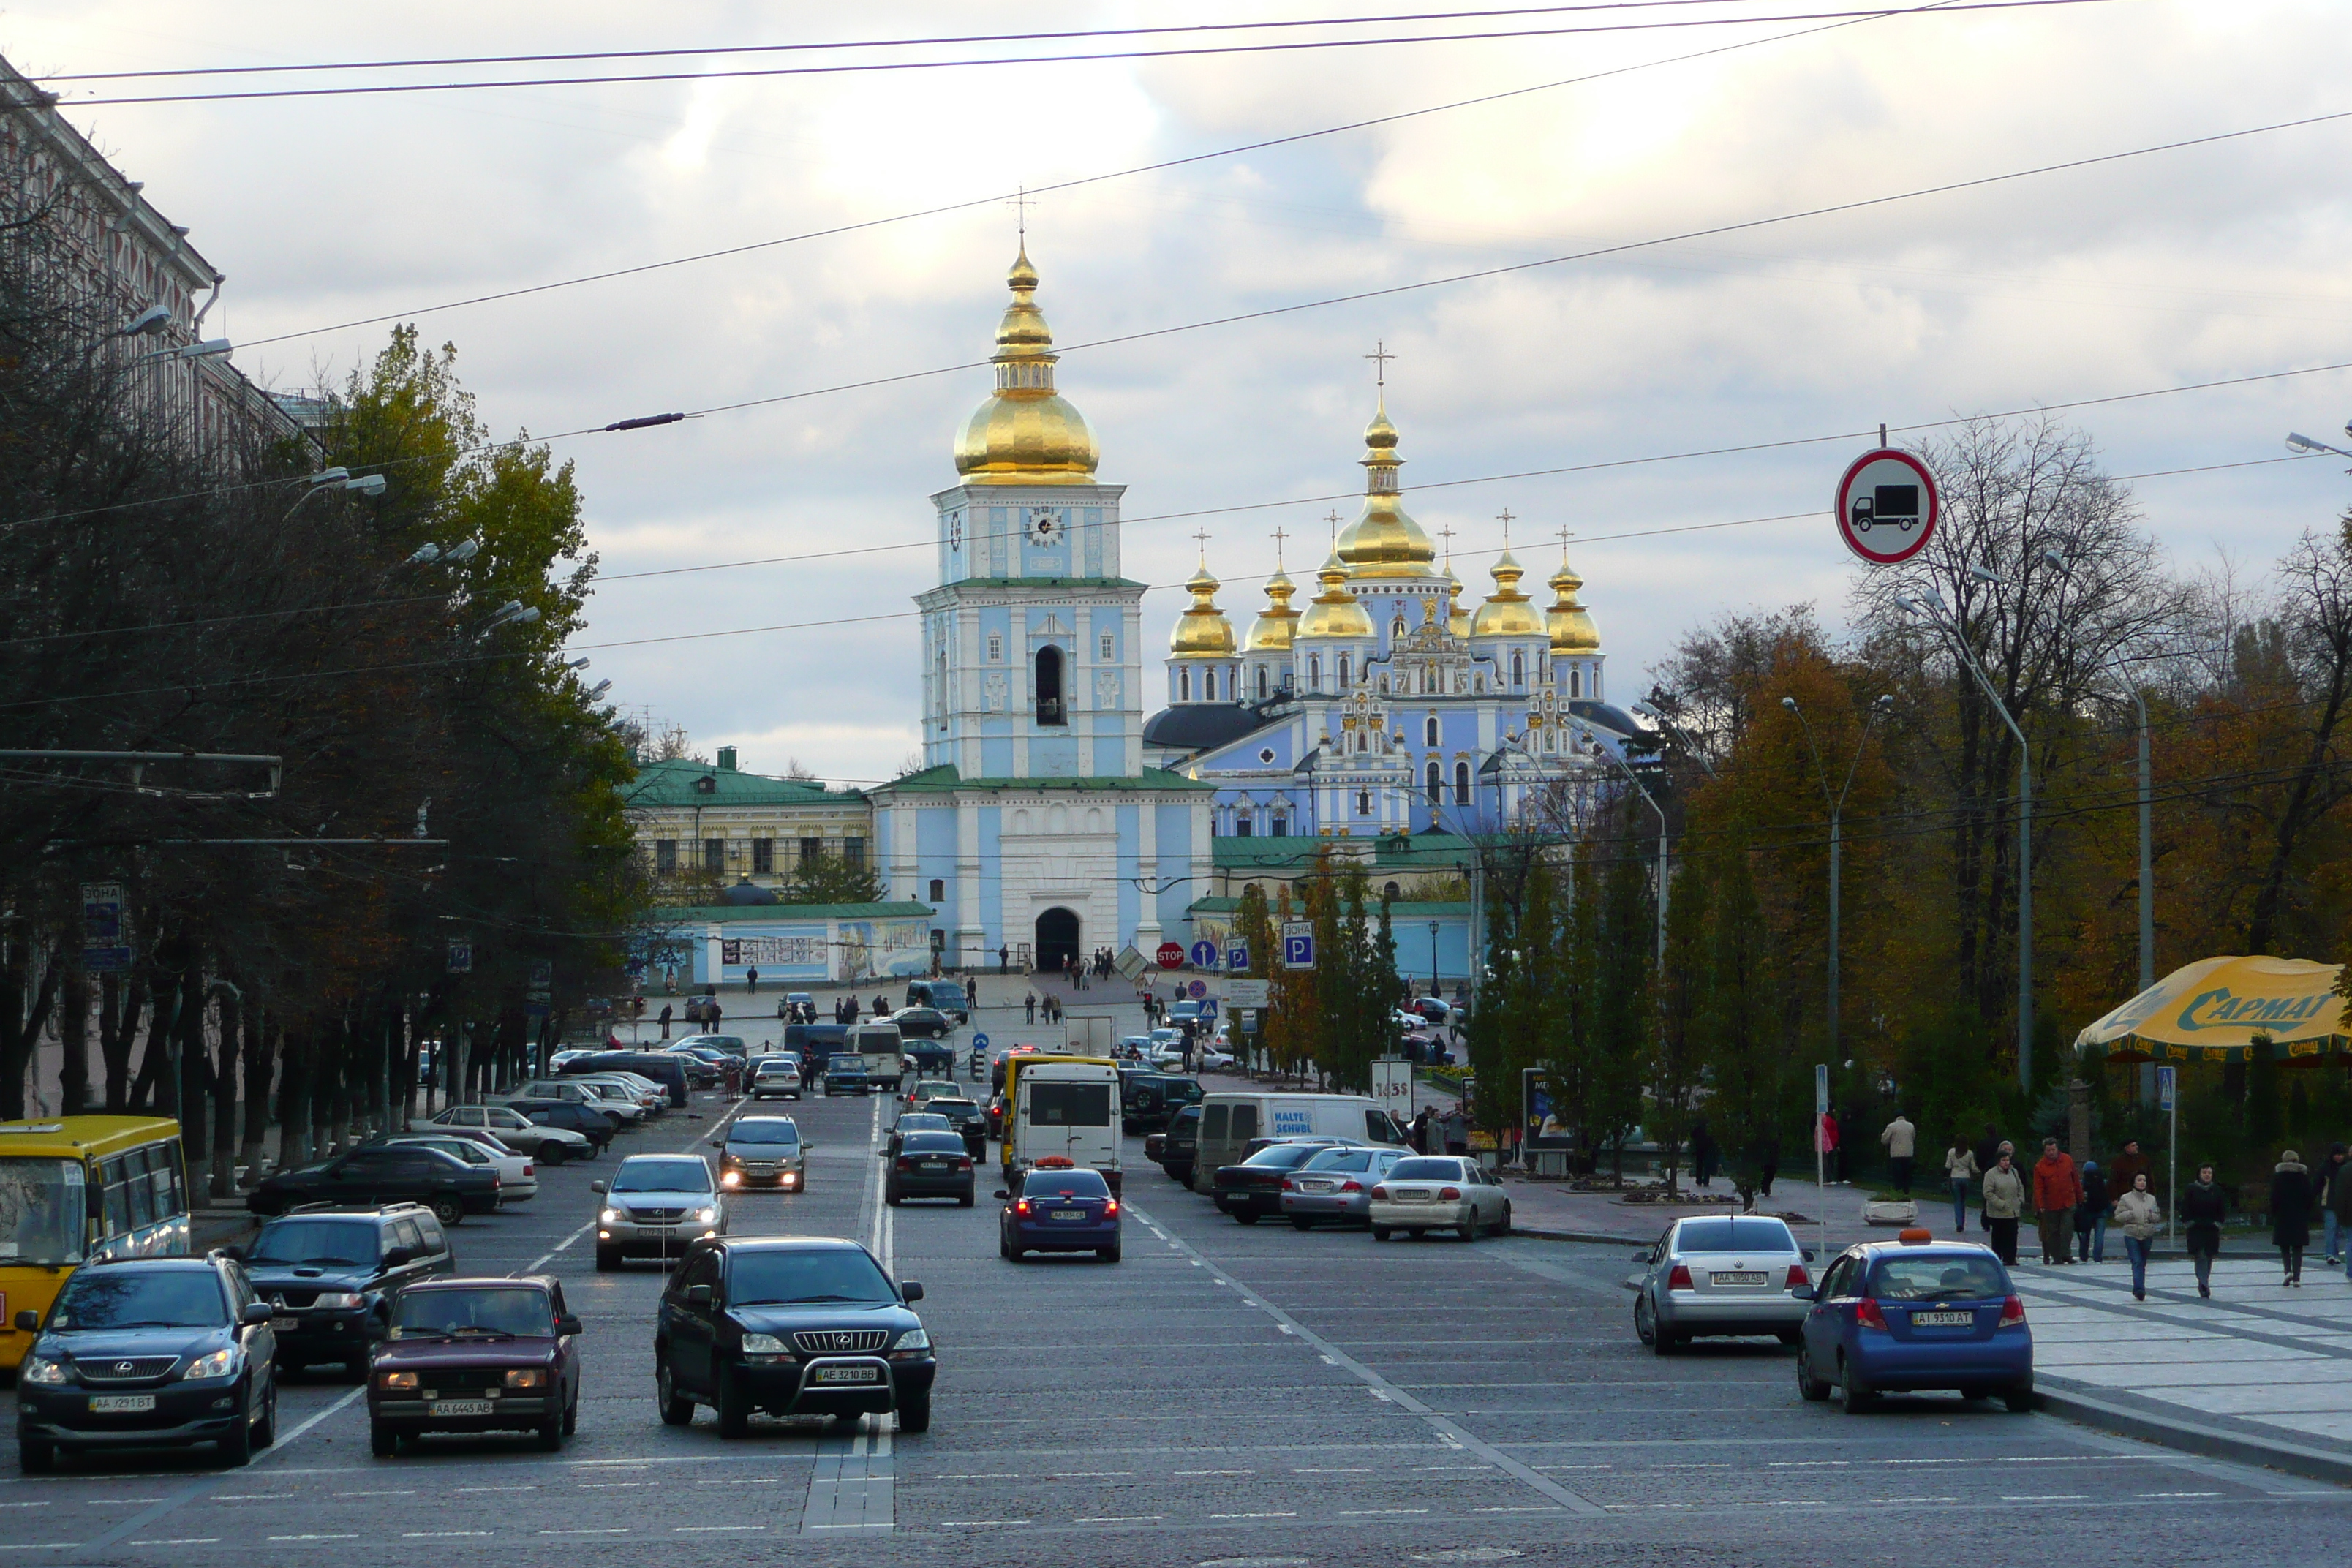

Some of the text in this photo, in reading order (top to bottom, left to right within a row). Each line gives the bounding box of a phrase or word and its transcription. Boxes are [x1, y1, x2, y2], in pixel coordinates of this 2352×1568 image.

[1286, 925, 1311, 935] ЗОНА
[1158, 951, 1183, 961] STOP
[1292, 940, 1305, 962] P
[2176, 987, 2337, 1032] САРМАТ
[1956, 1313, 1969, 1322] AT
[823, 1370, 874, 1379] AE 3210 BB
[97, 1398, 109, 1408] AA
[137, 1397, 152, 1407] BT
[437, 1403, 490, 1414] AA 6445 AB
